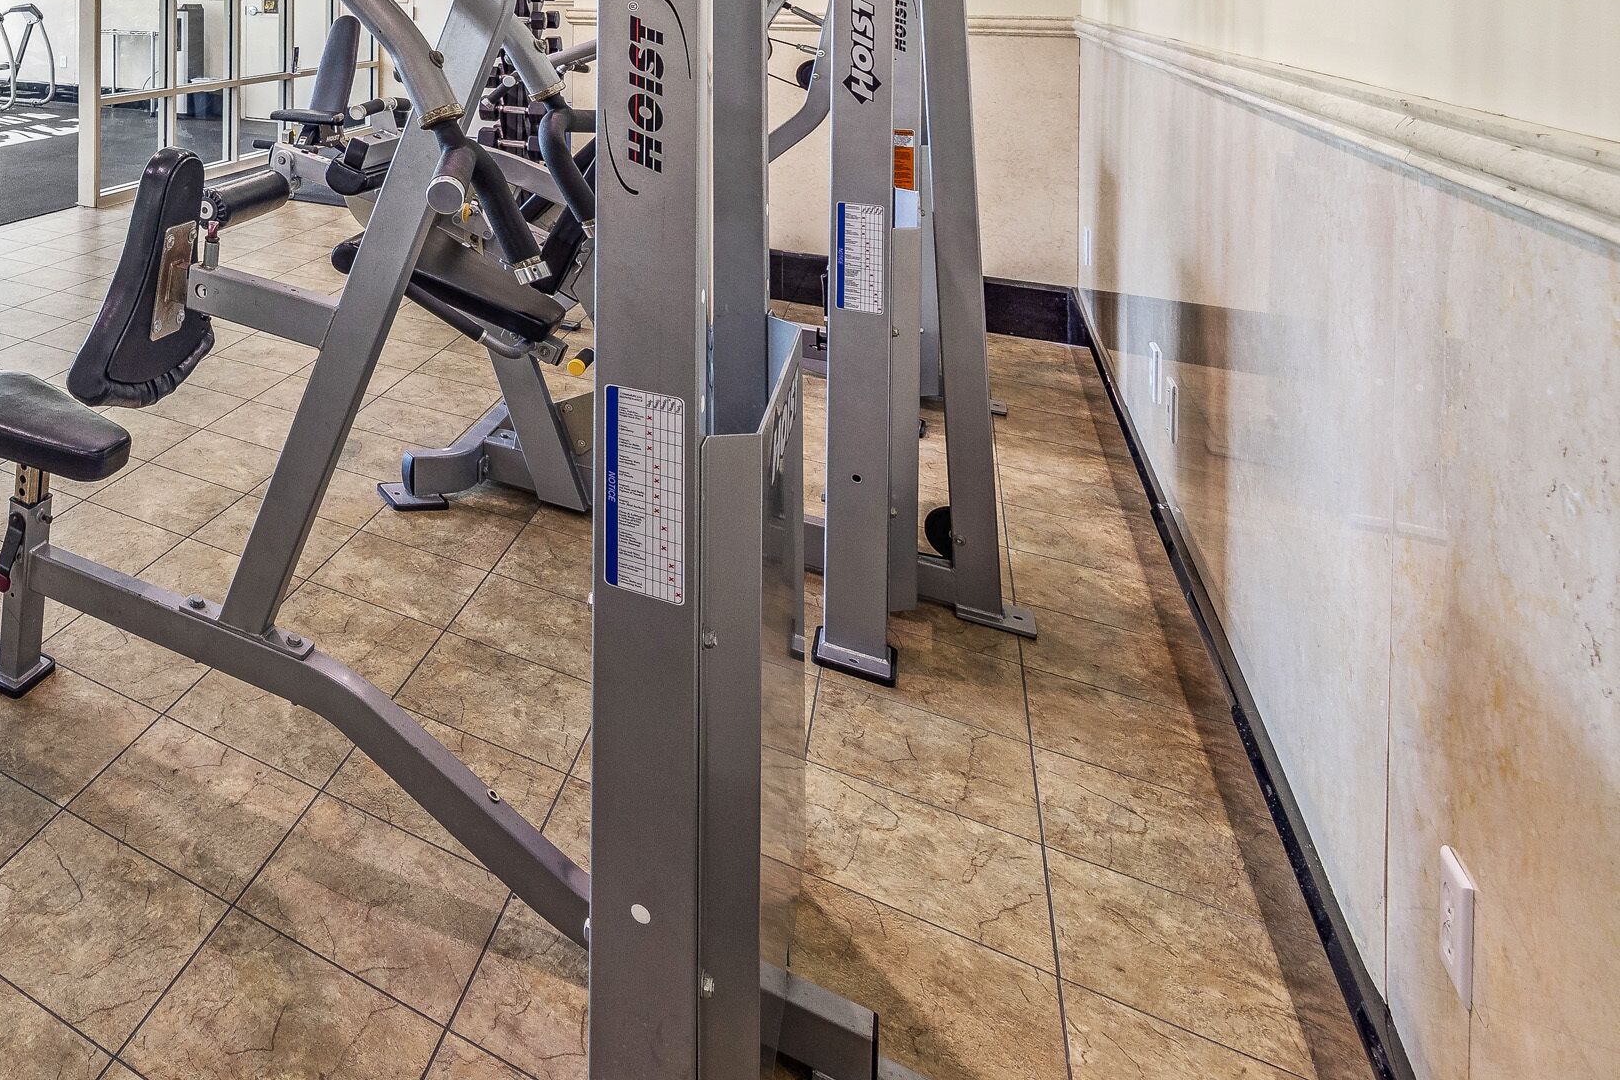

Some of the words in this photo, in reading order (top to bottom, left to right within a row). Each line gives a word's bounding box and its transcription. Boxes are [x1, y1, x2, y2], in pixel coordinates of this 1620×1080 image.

[628, 15, 664, 174] HOIST
[608, 470, 616, 502] NOTICE
[770, 365, 800, 486] HOIST
